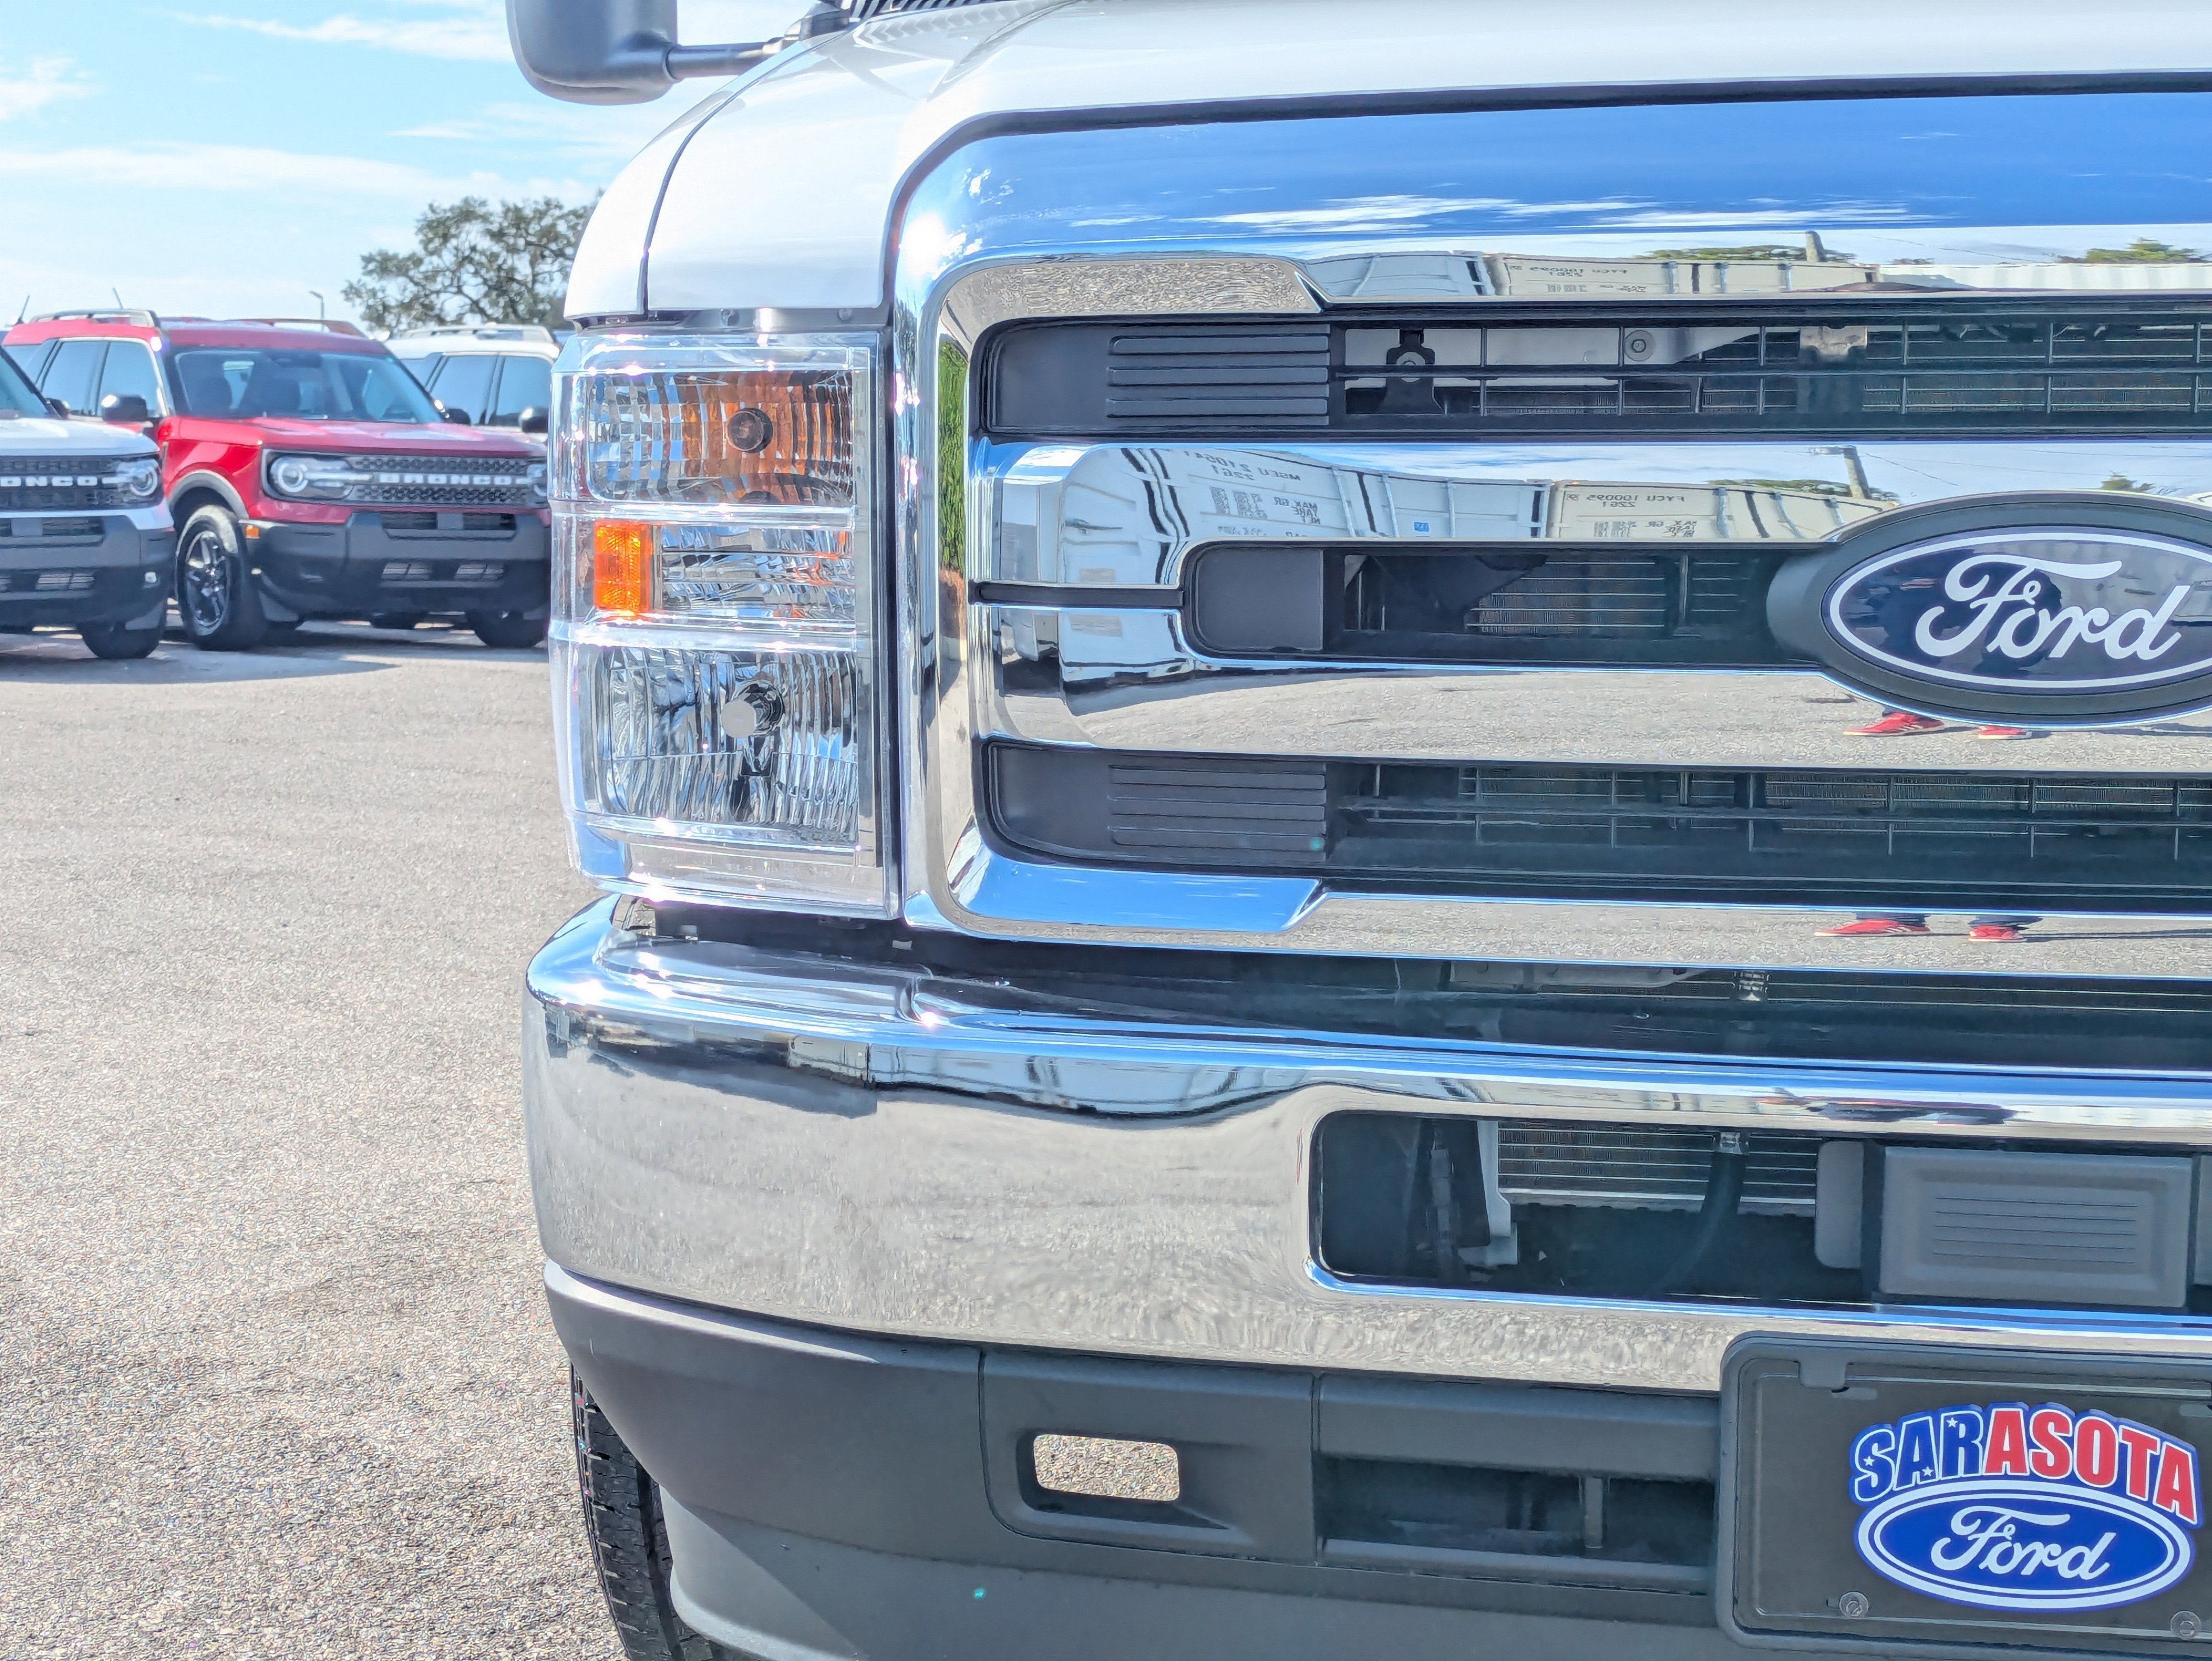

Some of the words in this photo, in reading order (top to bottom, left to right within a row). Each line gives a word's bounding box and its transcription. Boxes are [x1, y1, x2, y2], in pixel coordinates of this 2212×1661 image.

[379, 473, 512, 485] BRONCO
[1915, 554, 2190, 660] Ford
[1854, 1407, 2198, 1523] SARASOTA
[1931, 1506, 2116, 1580] Ford
